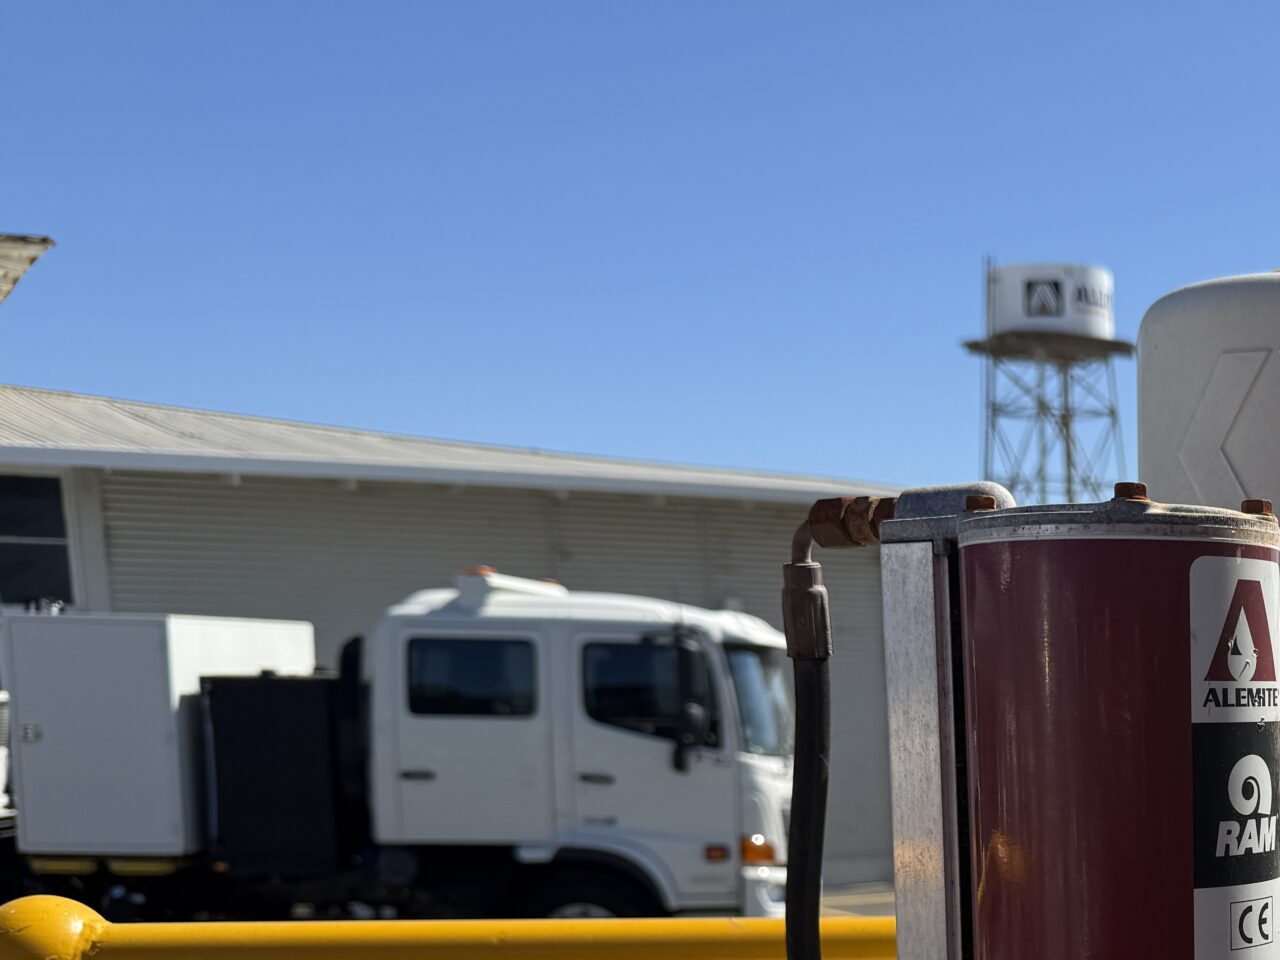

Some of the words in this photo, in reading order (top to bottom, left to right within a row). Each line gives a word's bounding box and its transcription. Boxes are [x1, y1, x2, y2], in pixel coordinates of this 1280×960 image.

[1202, 687, 1278, 708] ALEMITE
[1215, 816, 1276, 858] RAM
[1239, 902, 1269, 944] CE
